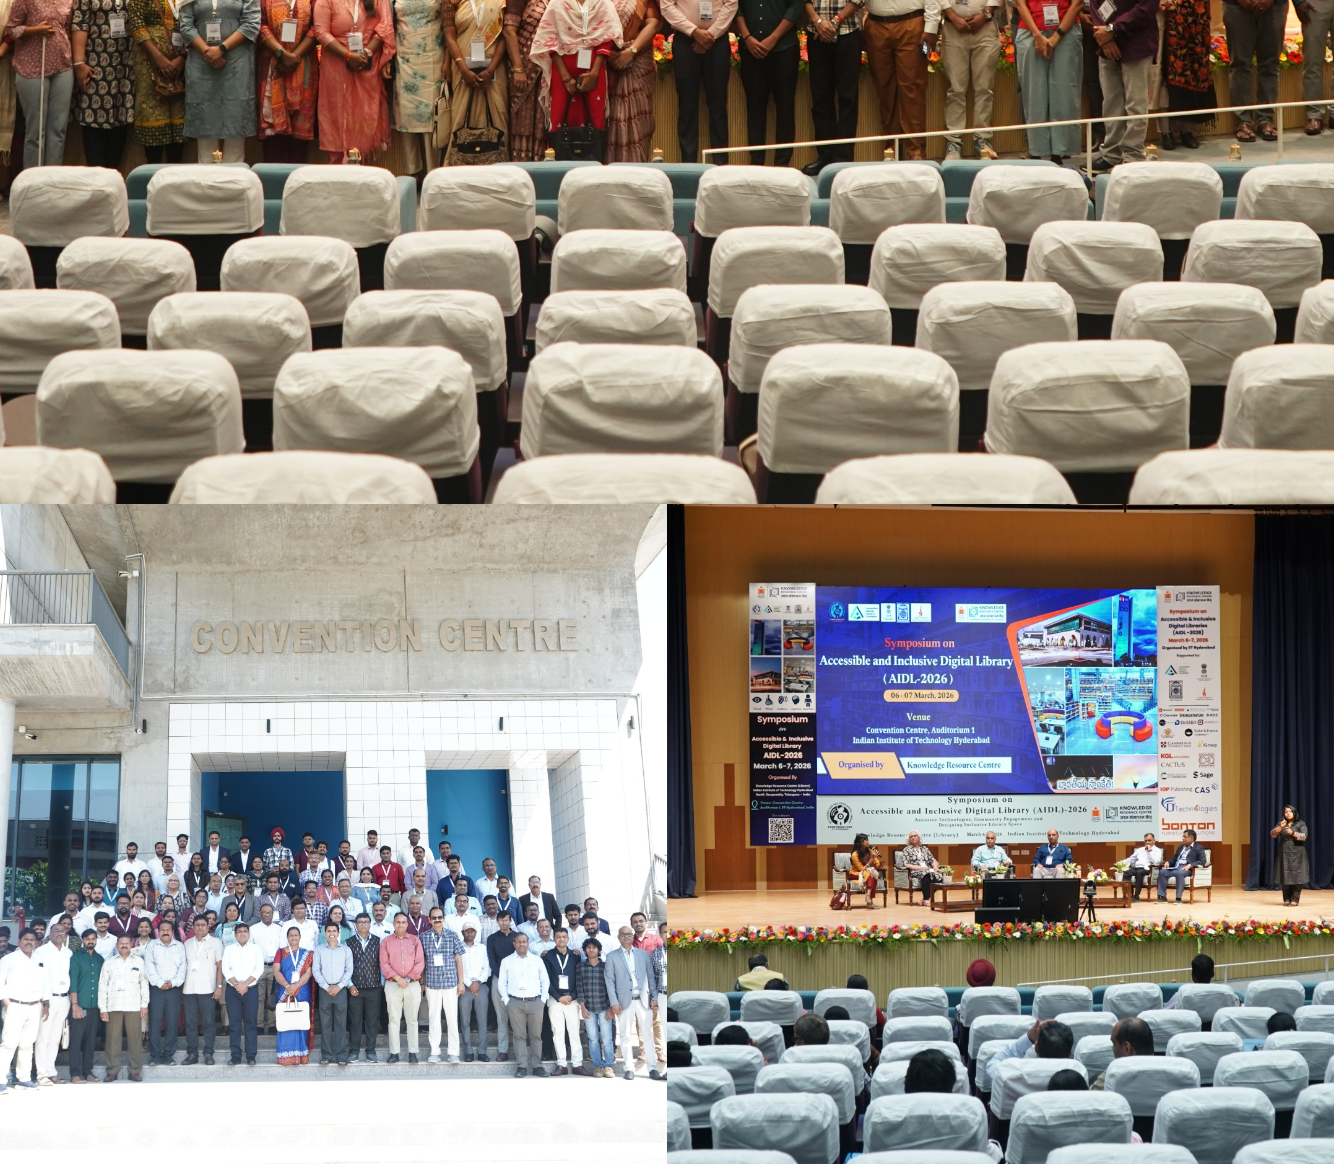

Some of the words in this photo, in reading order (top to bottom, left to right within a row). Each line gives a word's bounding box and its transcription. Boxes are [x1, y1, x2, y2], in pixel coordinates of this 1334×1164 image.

[191, 618, 422, 653] CONVENTION
[440, 618, 580, 652] CENTRE
[885, 637, 940, 650] Symposium
[820, 655, 870, 665] Accessible
[873, 655, 891, 665] and
[894, 655, 938, 666] Inclusive
[940, 656, 973, 669] Digital
[976, 656, 1013, 669] Library
[758, 715, 808, 724] Symposium
